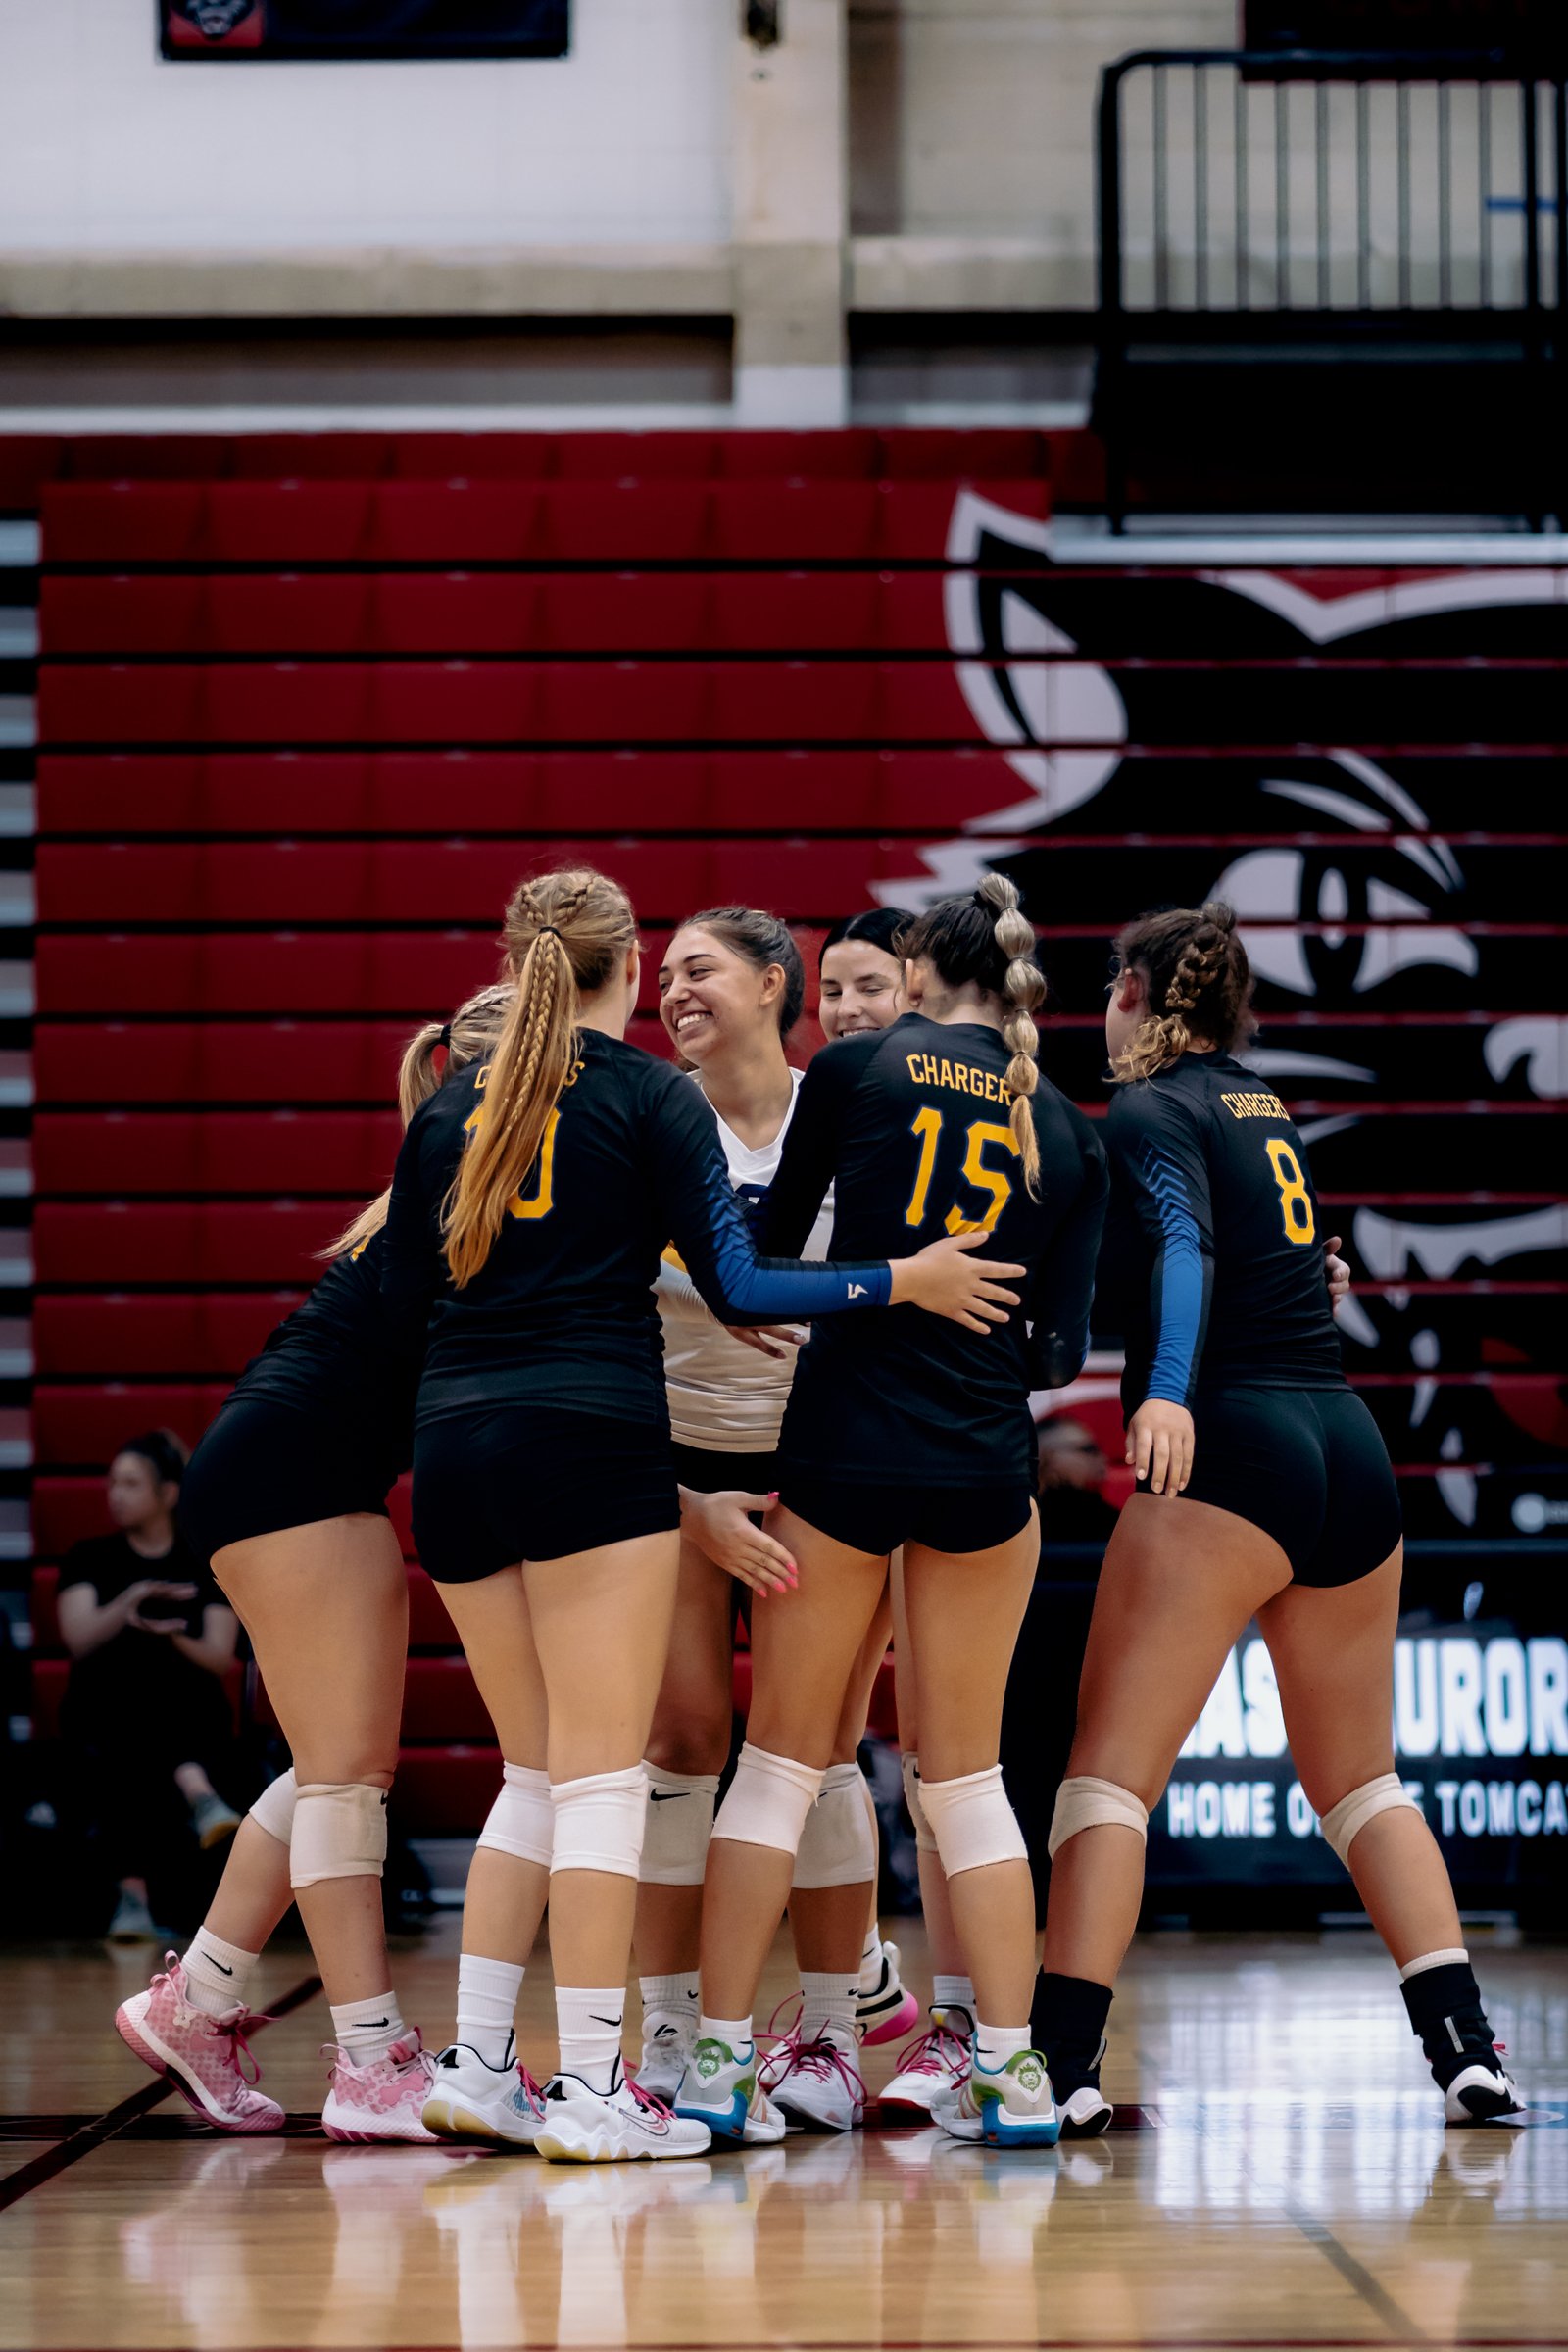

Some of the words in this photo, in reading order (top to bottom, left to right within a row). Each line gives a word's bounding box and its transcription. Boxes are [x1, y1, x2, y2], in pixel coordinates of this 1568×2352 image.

[906, 1054, 1013, 1107] CHARGER
[1220, 1092, 1291, 1122] CHARGERS
[904, 1105, 1021, 1237] 15
[1265, 1137, 1316, 1246] 8
[1177, 1638, 1289, 1758] AS
[1392, 1636, 1568, 1757] UROR
[1167, 1780, 1277, 1838] HOME
[1286, 1780, 1324, 1838] O
[1435, 1780, 1568, 1838] TOMCA
